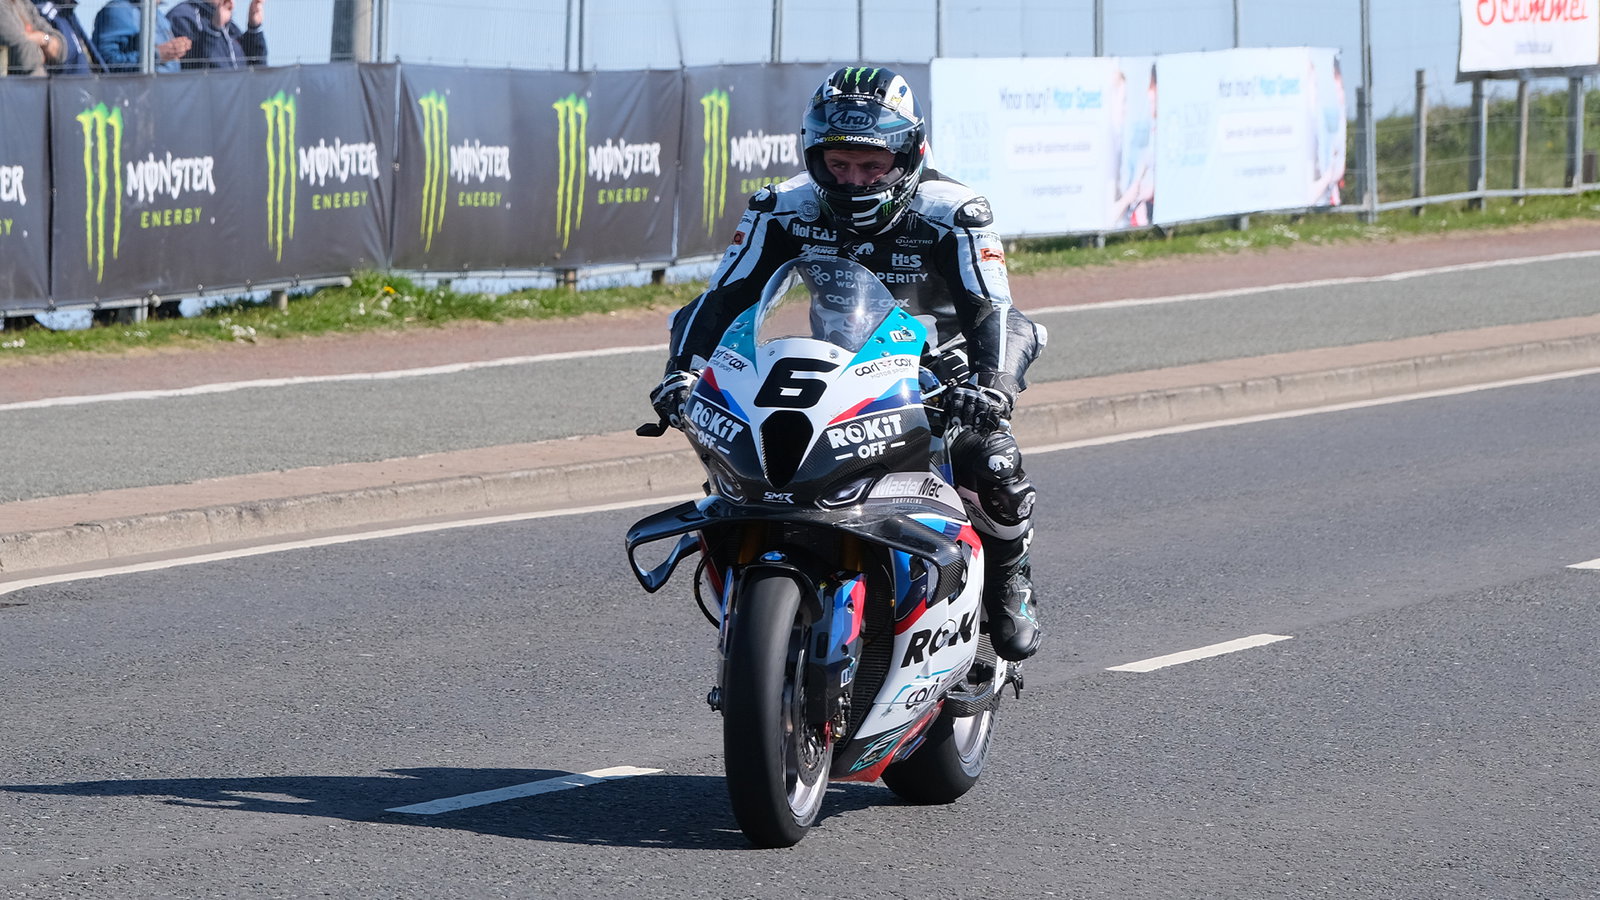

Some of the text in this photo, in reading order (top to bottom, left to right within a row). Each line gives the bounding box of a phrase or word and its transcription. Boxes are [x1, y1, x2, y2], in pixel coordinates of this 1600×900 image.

[832, 110, 870, 126] Arai
[312, 191, 369, 211] ENERGY
[458, 191, 502, 207] ENERGY
[598, 188, 649, 205] ENERGY
[140, 207, 203, 230] ENERGY
[854, 358, 914, 377] carl cox
[753, 357, 841, 409] 6
[857, 441, 886, 459] OFF
[763, 491, 795, 504] SMR
